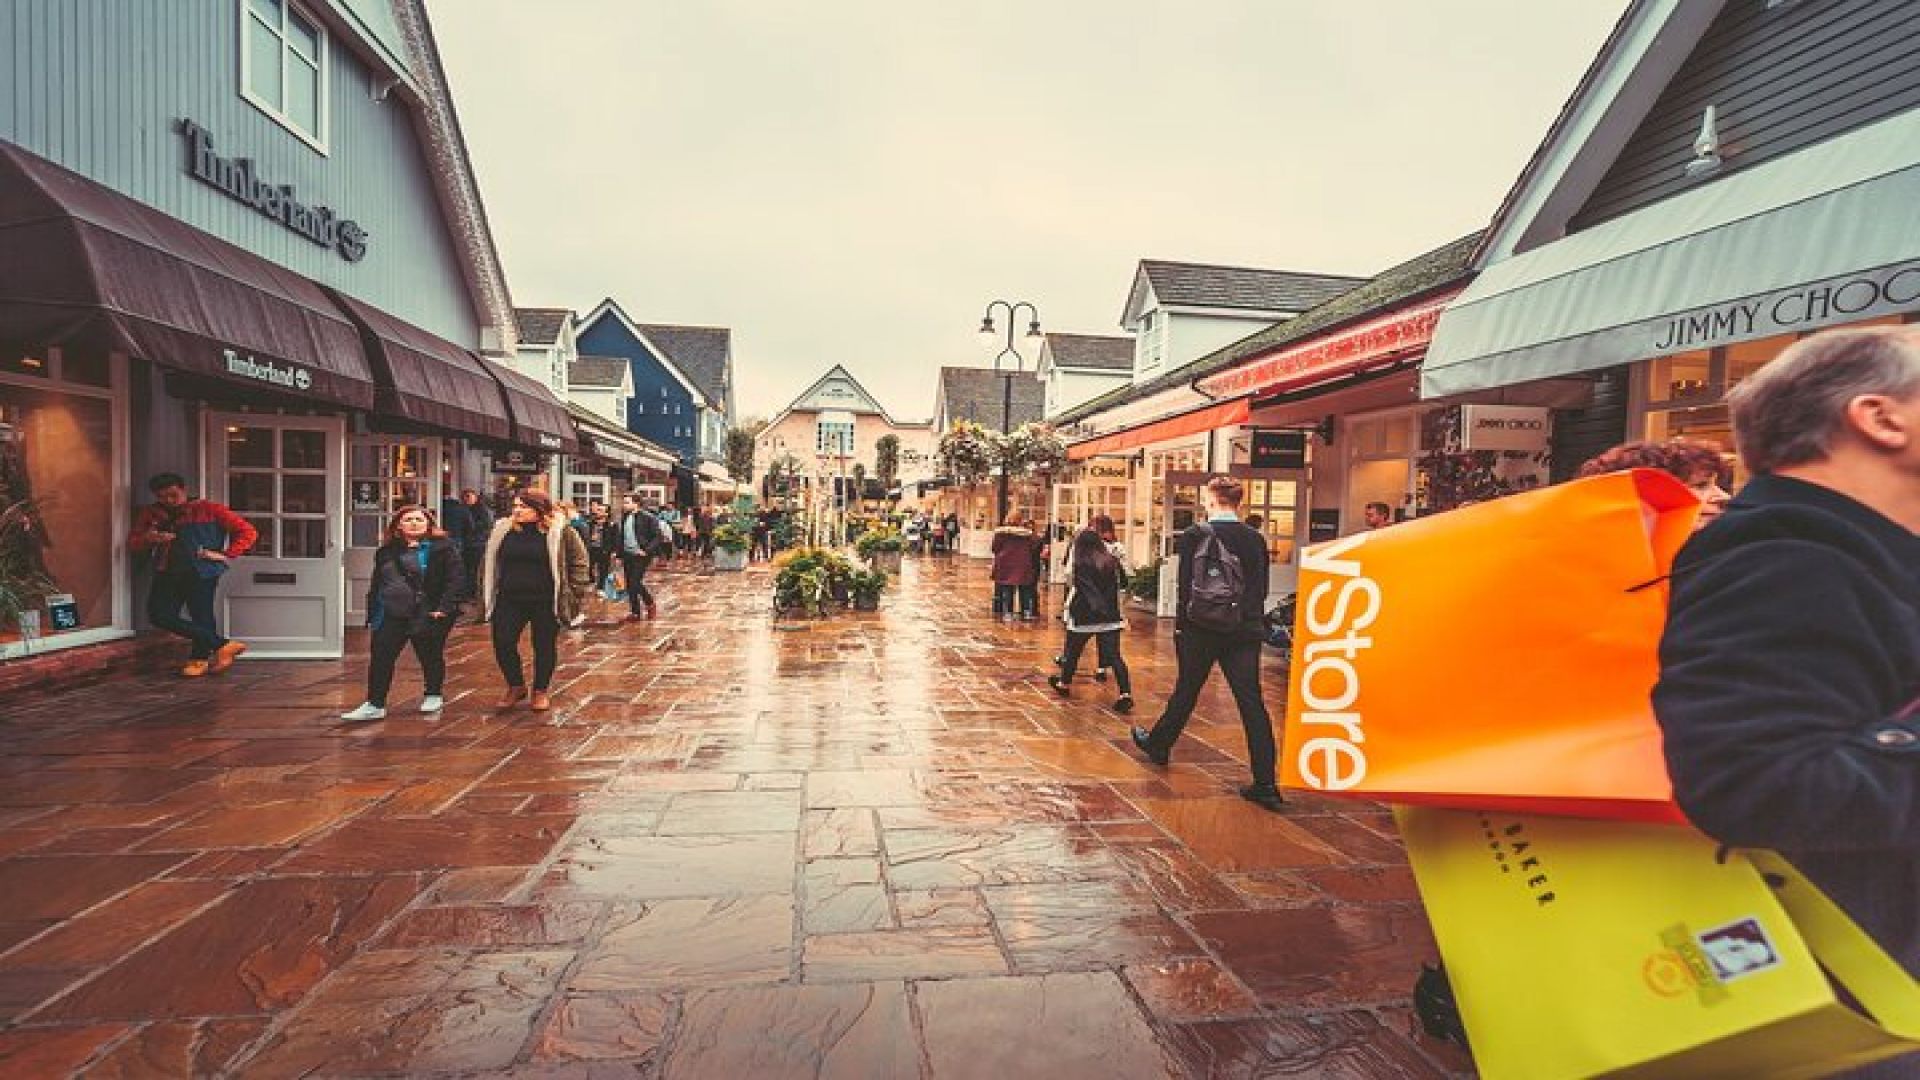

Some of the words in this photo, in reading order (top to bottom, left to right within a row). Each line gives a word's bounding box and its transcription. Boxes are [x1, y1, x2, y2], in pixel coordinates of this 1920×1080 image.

[174, 118, 336, 248] Timberland
[1656, 303, 1761, 349] JIMMY
[223, 348, 293, 387] Timberland
[1503, 823, 1555, 907] BAKER
